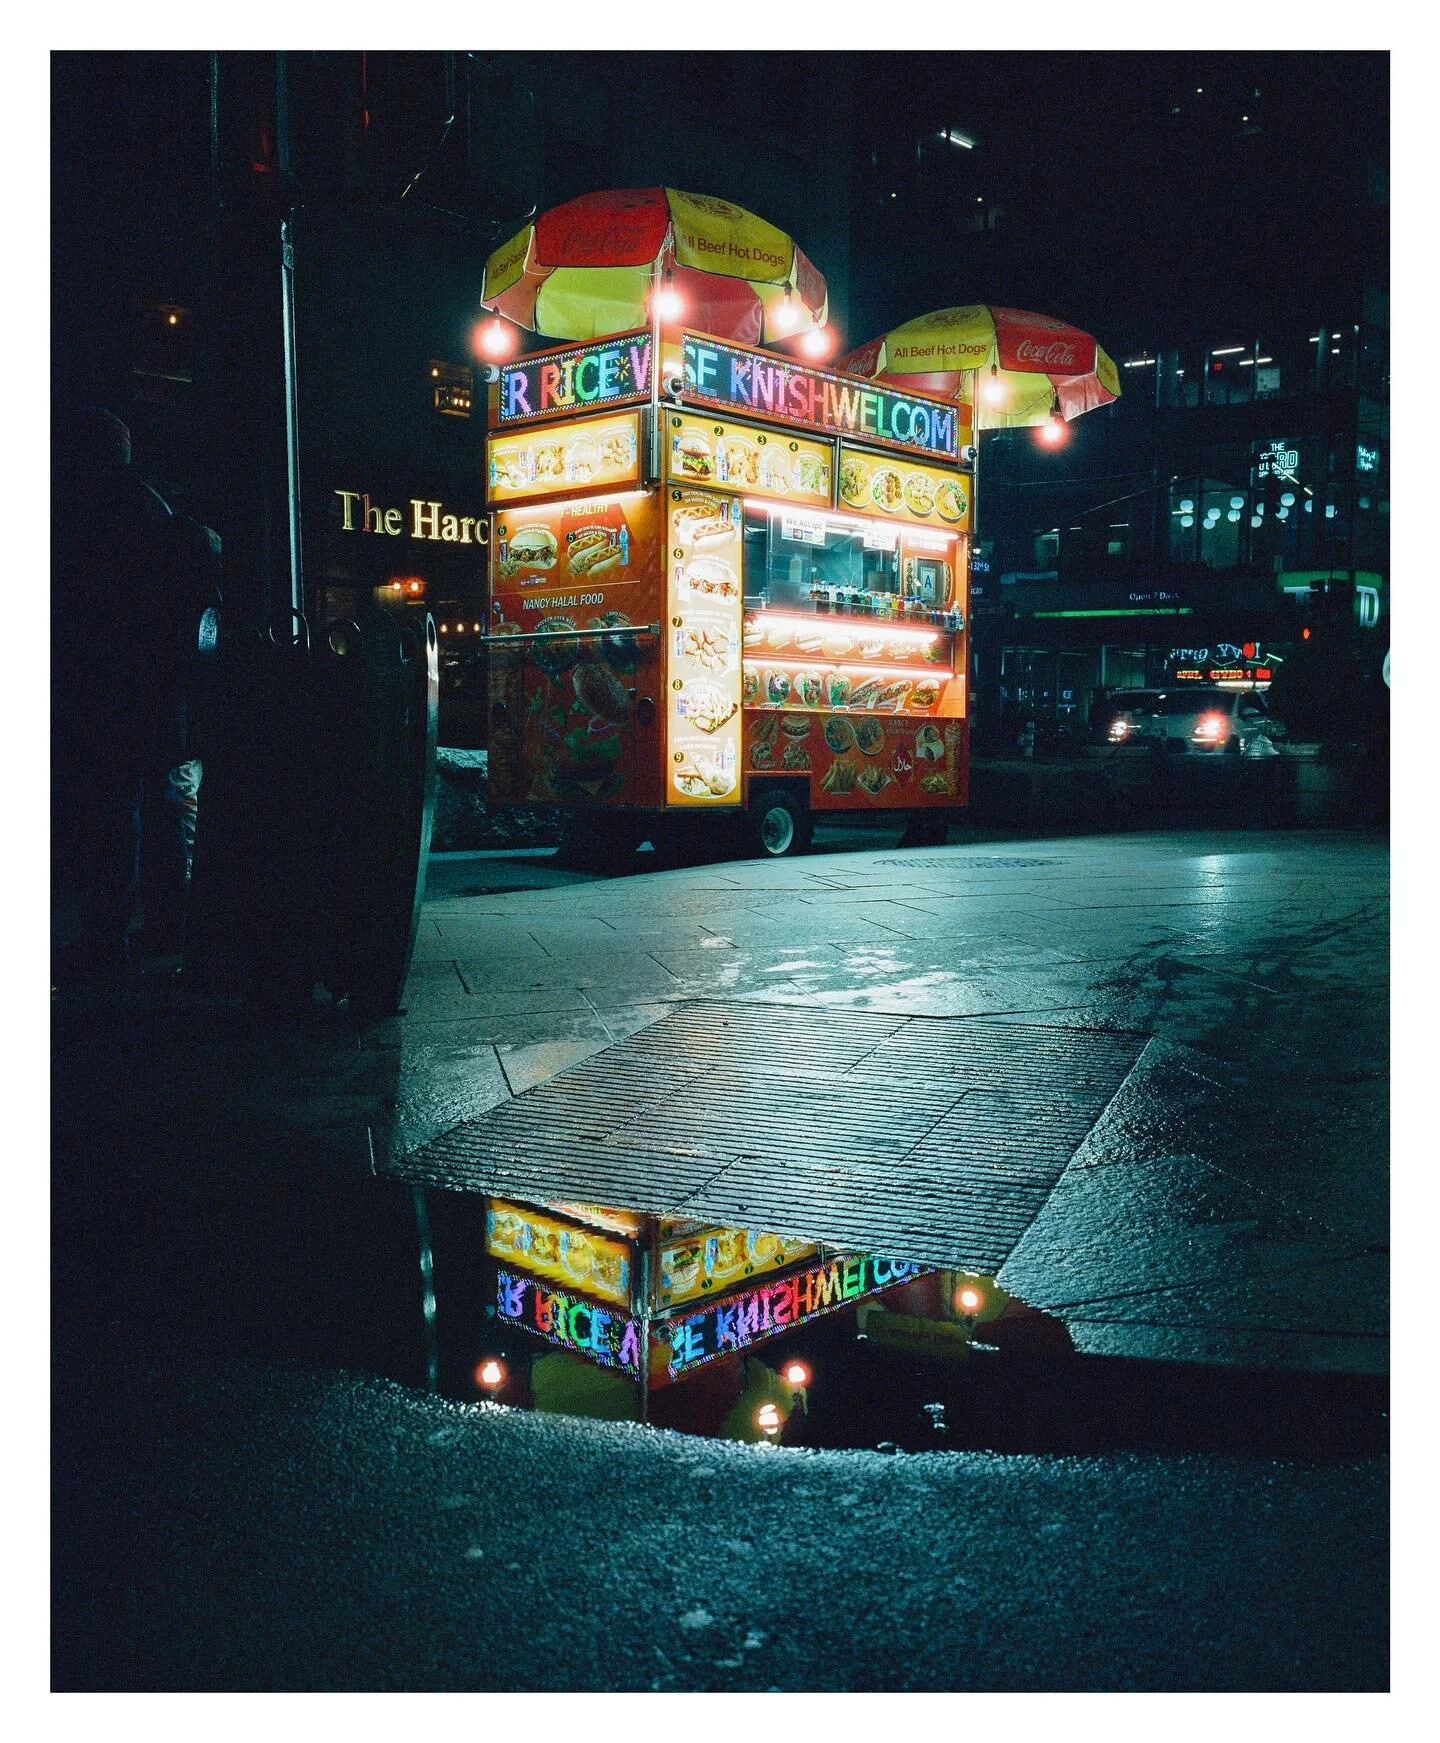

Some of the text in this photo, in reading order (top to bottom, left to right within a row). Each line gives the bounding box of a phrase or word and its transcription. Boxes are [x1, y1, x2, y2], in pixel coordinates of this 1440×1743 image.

[697, 239, 726, 254] Beef
[728, 243, 751, 259] Hot
[753, 250, 785, 267] Dogs
[894, 342, 987, 358] All Beef Hot Dogs
[540, 349, 620, 410] RICE
[1270, 443, 1285, 452] THE
[334, 490, 403, 536] The
[924, 574, 932, 589] A
[523, 592, 604, 610] NANCY HALAL FOOD
[893, 756, 912, 772] حلال
